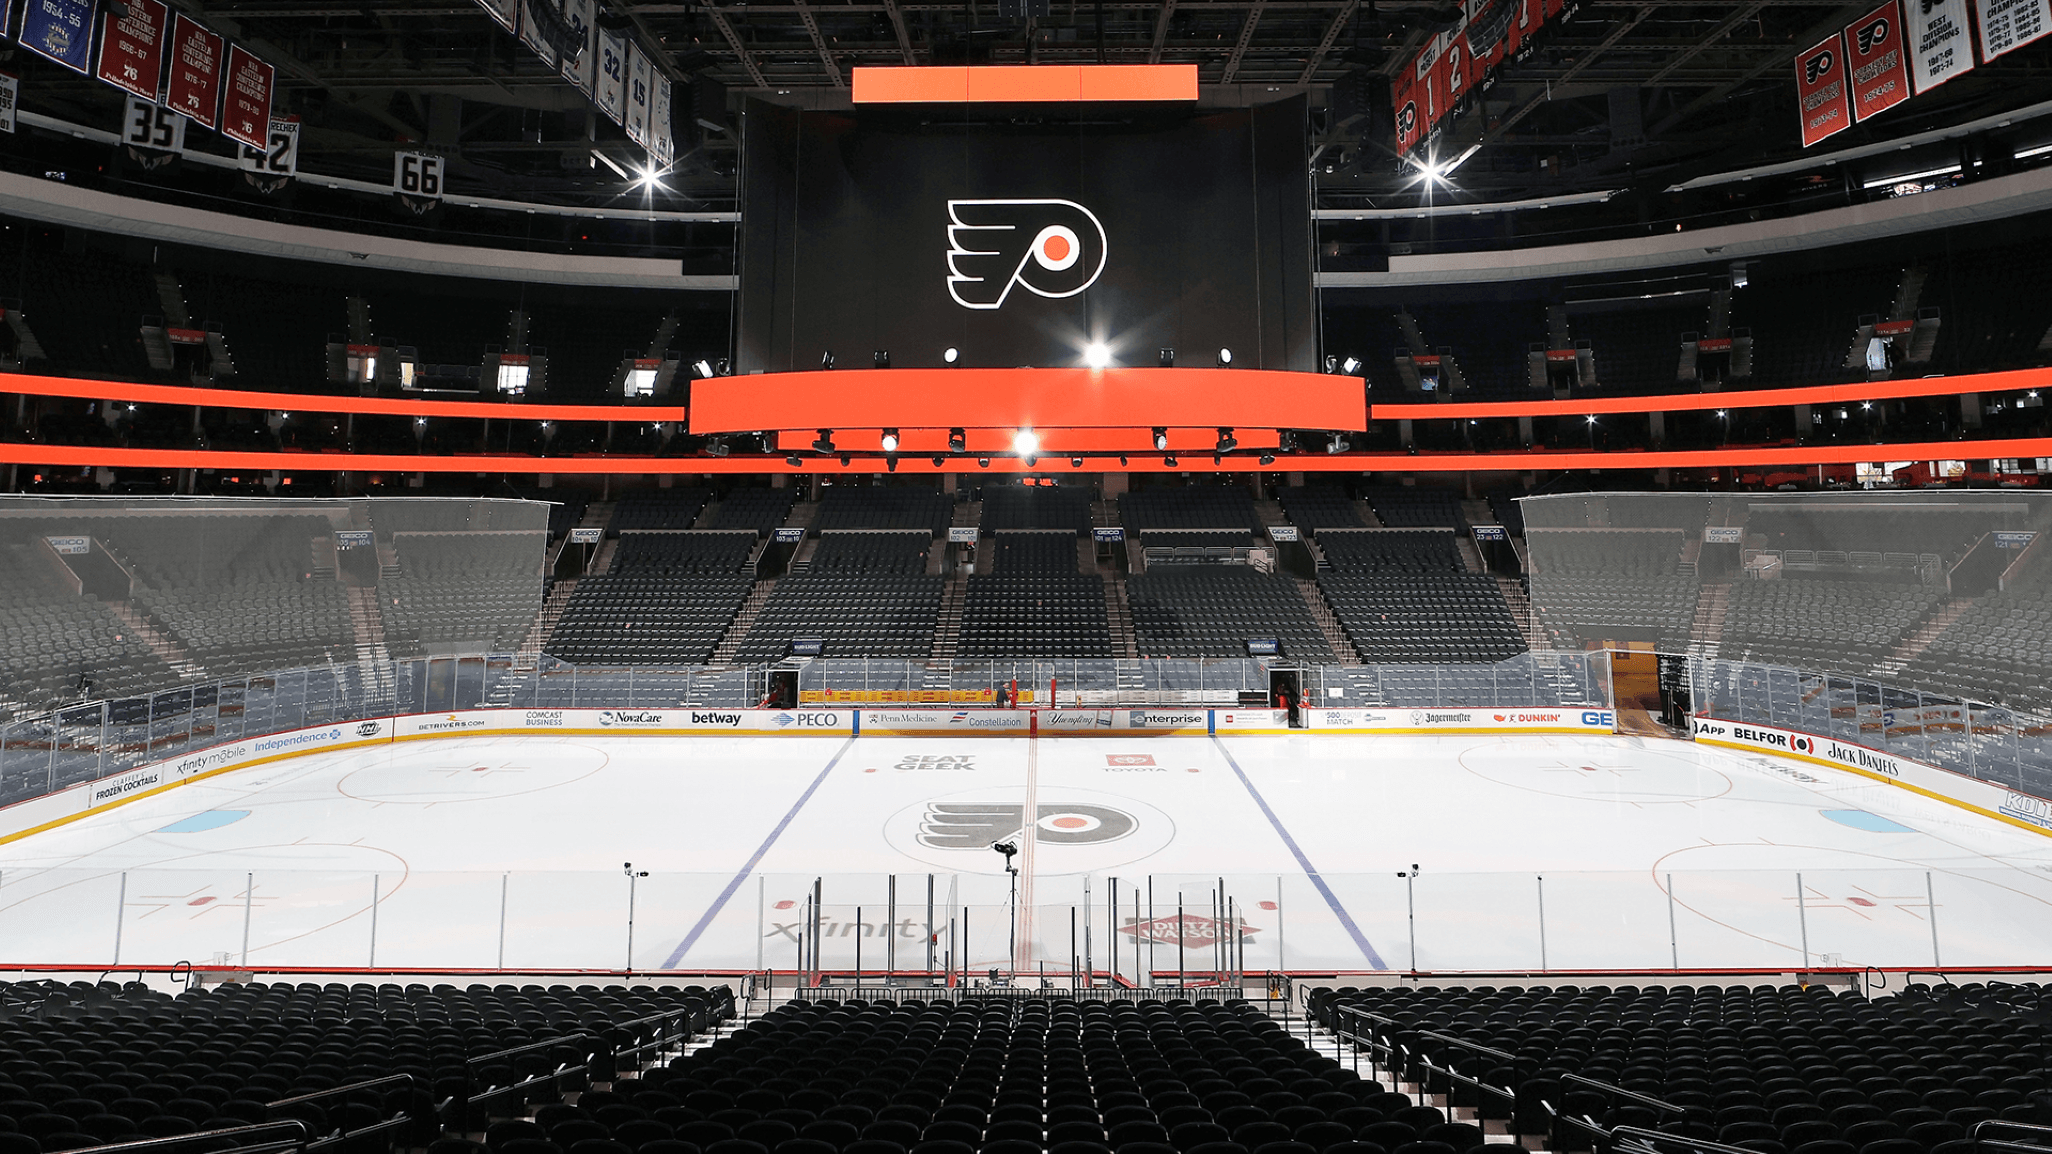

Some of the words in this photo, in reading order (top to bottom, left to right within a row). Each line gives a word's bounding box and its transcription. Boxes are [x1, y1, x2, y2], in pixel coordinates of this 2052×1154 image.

[1922, 20, 1953, 43] DIVISION
[1927, 14, 1946, 31] WEST
[1919, 27, 1960, 54] CHAMPIONS
[123, 63, 138, 81] 76
[604, 48, 620, 83] 32
[1450, 45, 1462, 94] 2
[633, 77, 646, 107] 15
[1427, 75, 1434, 117] 1
[131, 102, 175, 147] 35
[402, 156, 438, 194] 66
[526, 711, 563, 719] COMCAST
[615, 711, 662, 723] NovaCare
[691, 711, 742, 727] betway
[797, 713, 838, 727] PECO
[881, 714, 899, 723] Penn
[900, 714, 938, 723] Medicine
[969, 717, 1021, 727] Constellation
[1047, 711, 1094, 727] Yuengling
[1136, 713, 1202, 725] enterprise
[254, 731, 328, 751] Independence
[1734, 727, 1787, 747] BELFOR
[177, 756, 208, 774] xfinity
[208, 746, 246, 764] mobile
[901, 755, 976, 763] SEAT
[1828, 742, 1855, 764] JACK
[893, 763, 976, 771] GEEK
[96, 784, 122, 800] FROZEN
[123, 774, 158, 792] COCKTAILS
[764, 916, 947, 944] xfinity
